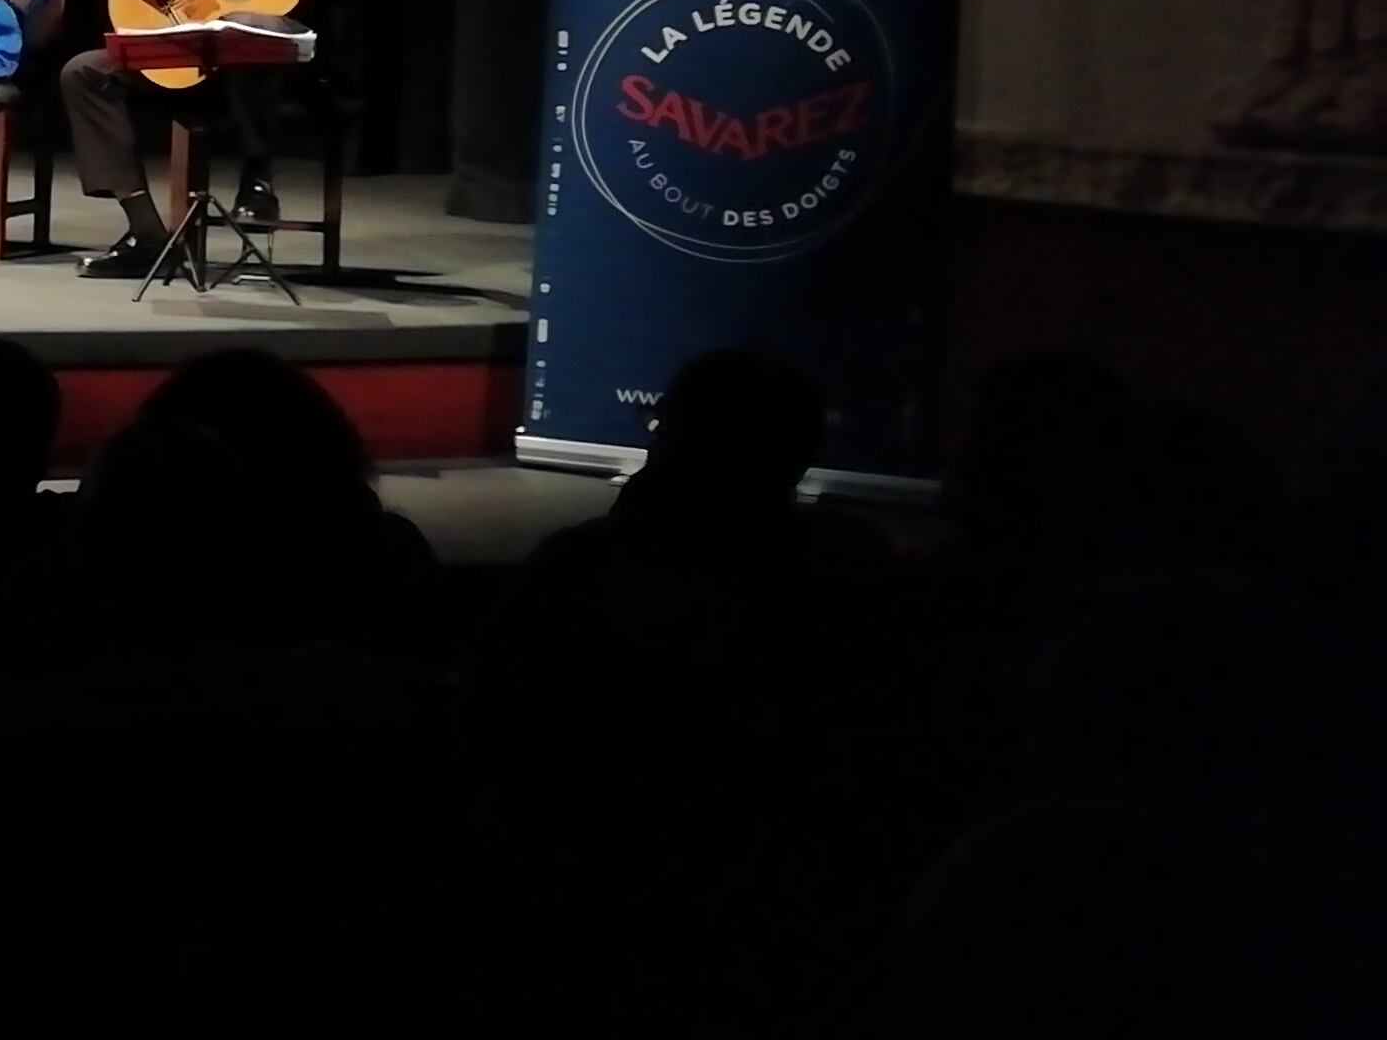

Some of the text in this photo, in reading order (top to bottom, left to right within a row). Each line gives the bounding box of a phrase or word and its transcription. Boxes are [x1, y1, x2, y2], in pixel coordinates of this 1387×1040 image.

[640, 26, 688, 64] LA
[616, 73, 875, 160] SAVAREZ
[628, 138, 857, 228] AU BOUT DES DOIGTS
